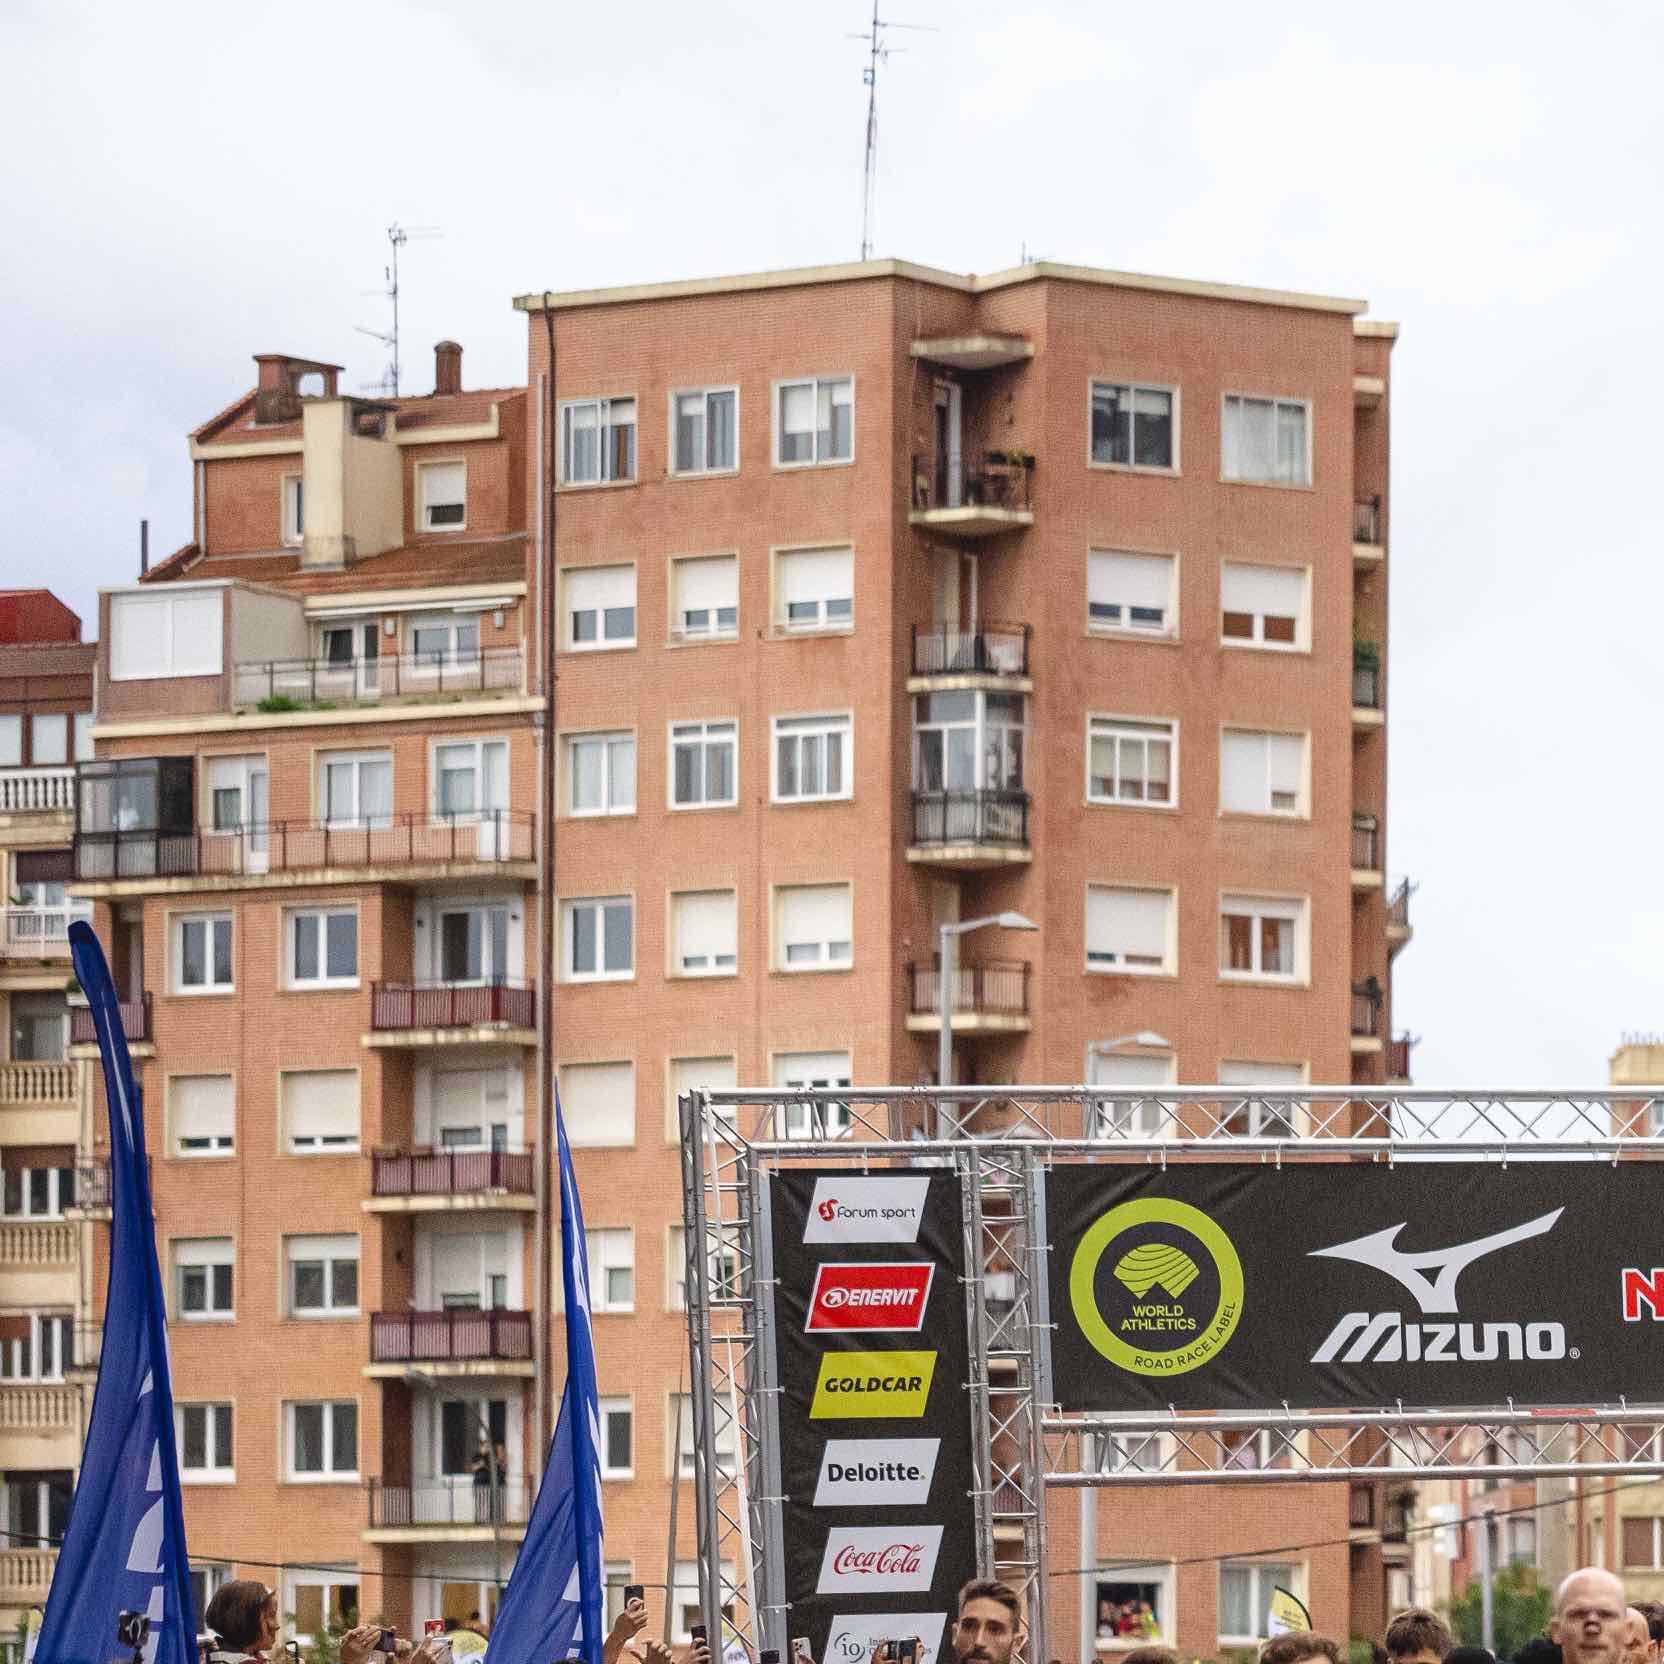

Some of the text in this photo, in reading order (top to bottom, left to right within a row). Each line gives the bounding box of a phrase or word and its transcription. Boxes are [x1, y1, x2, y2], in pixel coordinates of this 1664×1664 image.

[880, 1206, 916, 1220] sport
[847, 1288, 919, 1306] ENERVIT
[1133, 1305, 1184, 1317] WORLD
[1121, 1318, 1197, 1331] ATHLETICS
[1134, 1301, 1236, 1369] ROAD RACE LABEL
[1310, 1312, 1566, 1362] MIZUNO
[825, 1376, 922, 1393] GOLDCAR
[834, 1544, 926, 1574] Coca-Cola
